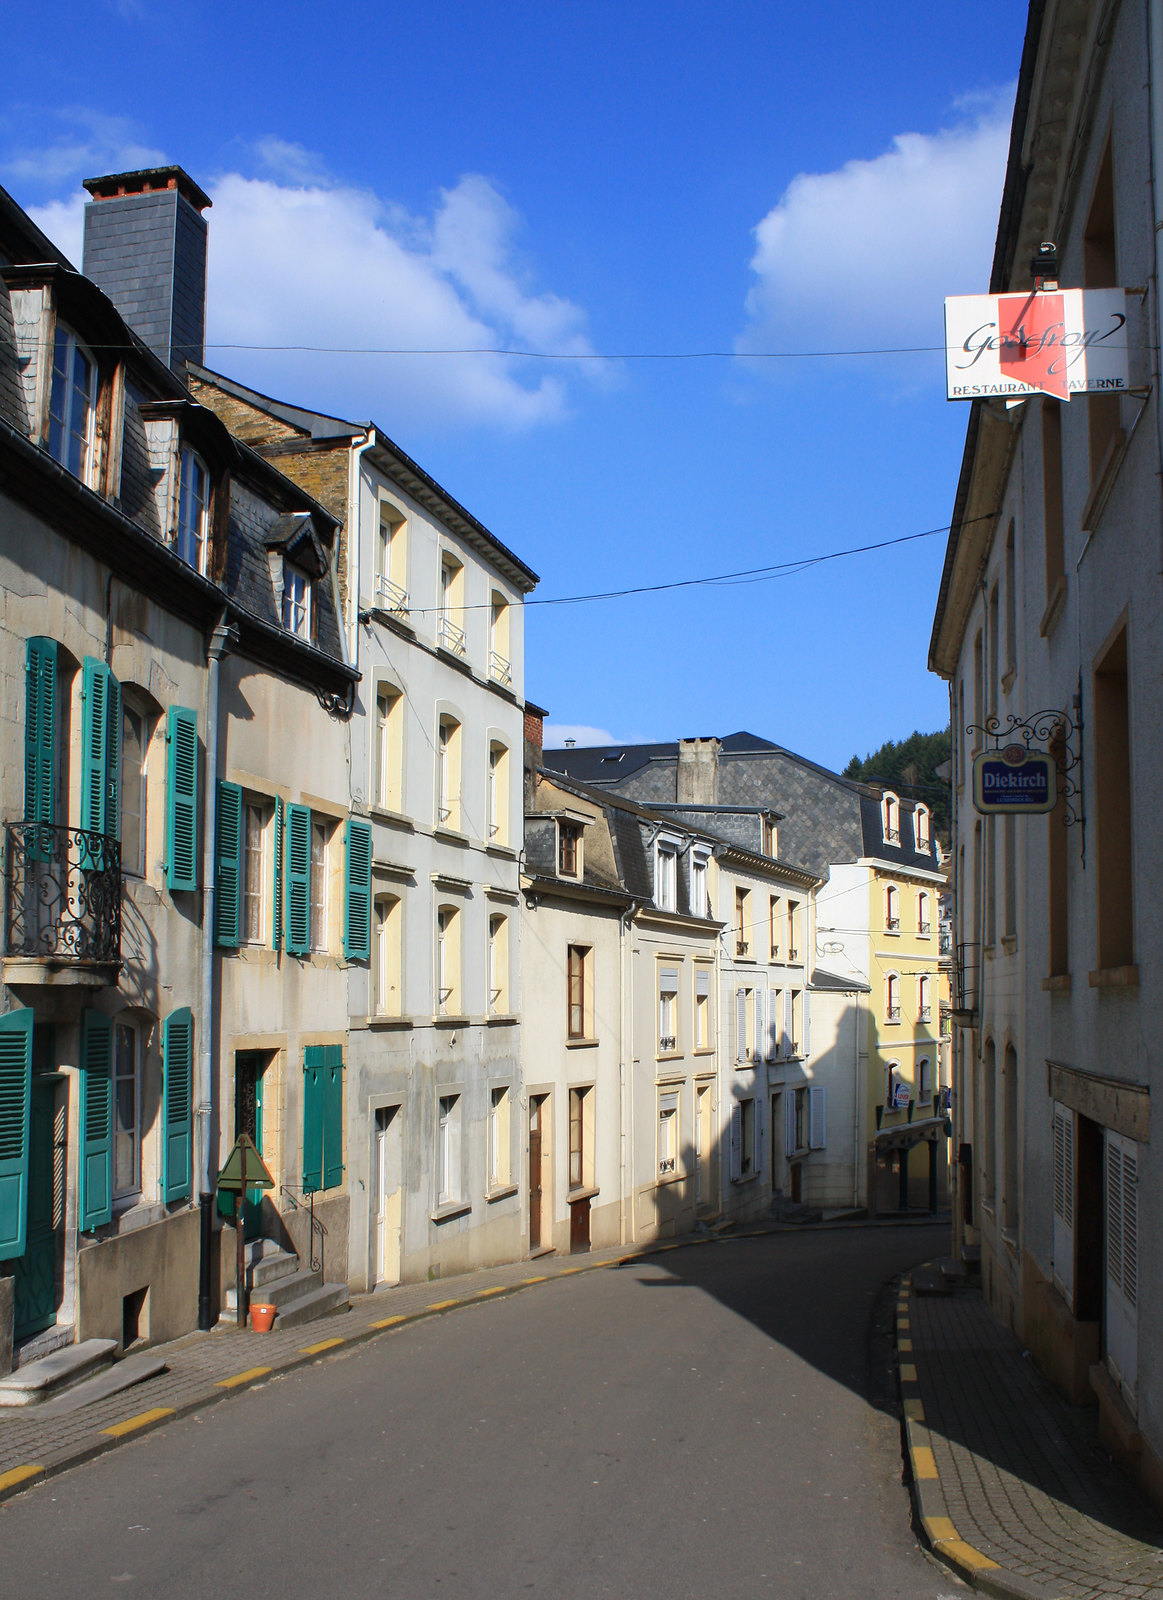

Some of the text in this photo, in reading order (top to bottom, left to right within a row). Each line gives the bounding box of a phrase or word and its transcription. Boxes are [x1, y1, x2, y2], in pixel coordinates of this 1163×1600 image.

[952, 381, 1046, 396] RESTAURANT
[1061, 377, 1126, 391] TAVERNE
[983, 772, 1047, 788] Diekirch
